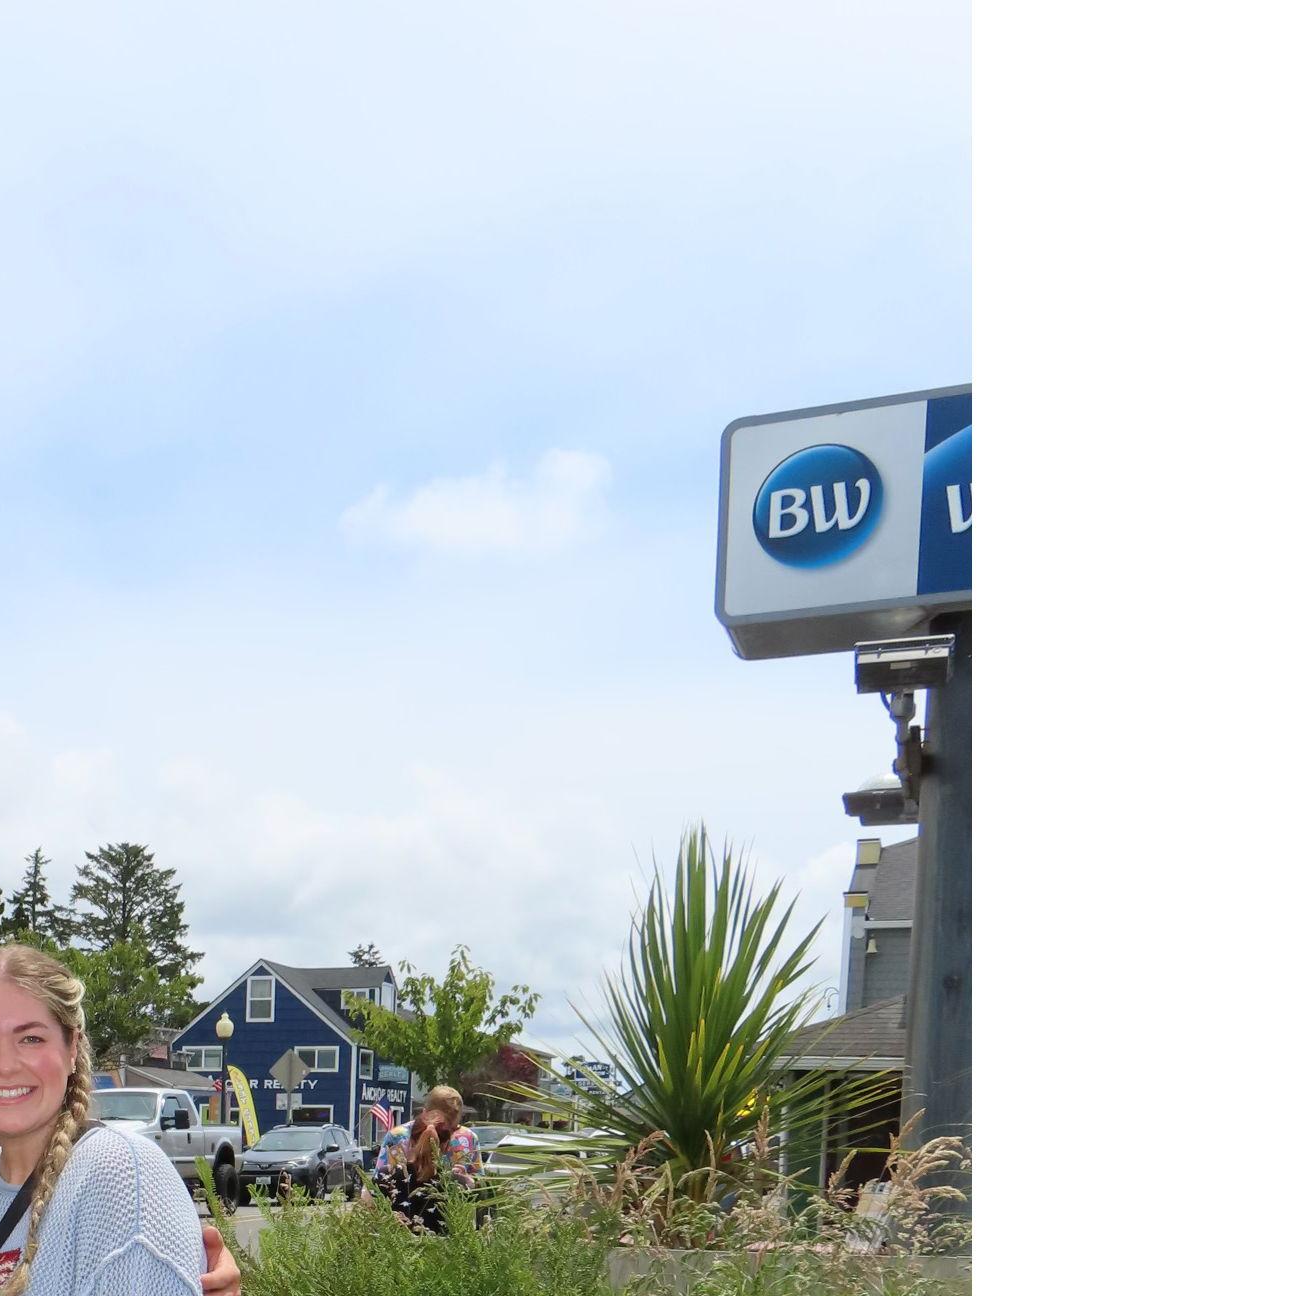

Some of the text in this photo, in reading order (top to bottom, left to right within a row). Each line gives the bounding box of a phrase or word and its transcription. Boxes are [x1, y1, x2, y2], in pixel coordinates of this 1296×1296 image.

[768, 477, 871, 539] BW
[264, 1080, 318, 1089] RETY
[387, 1089, 407, 1103] REALTY
